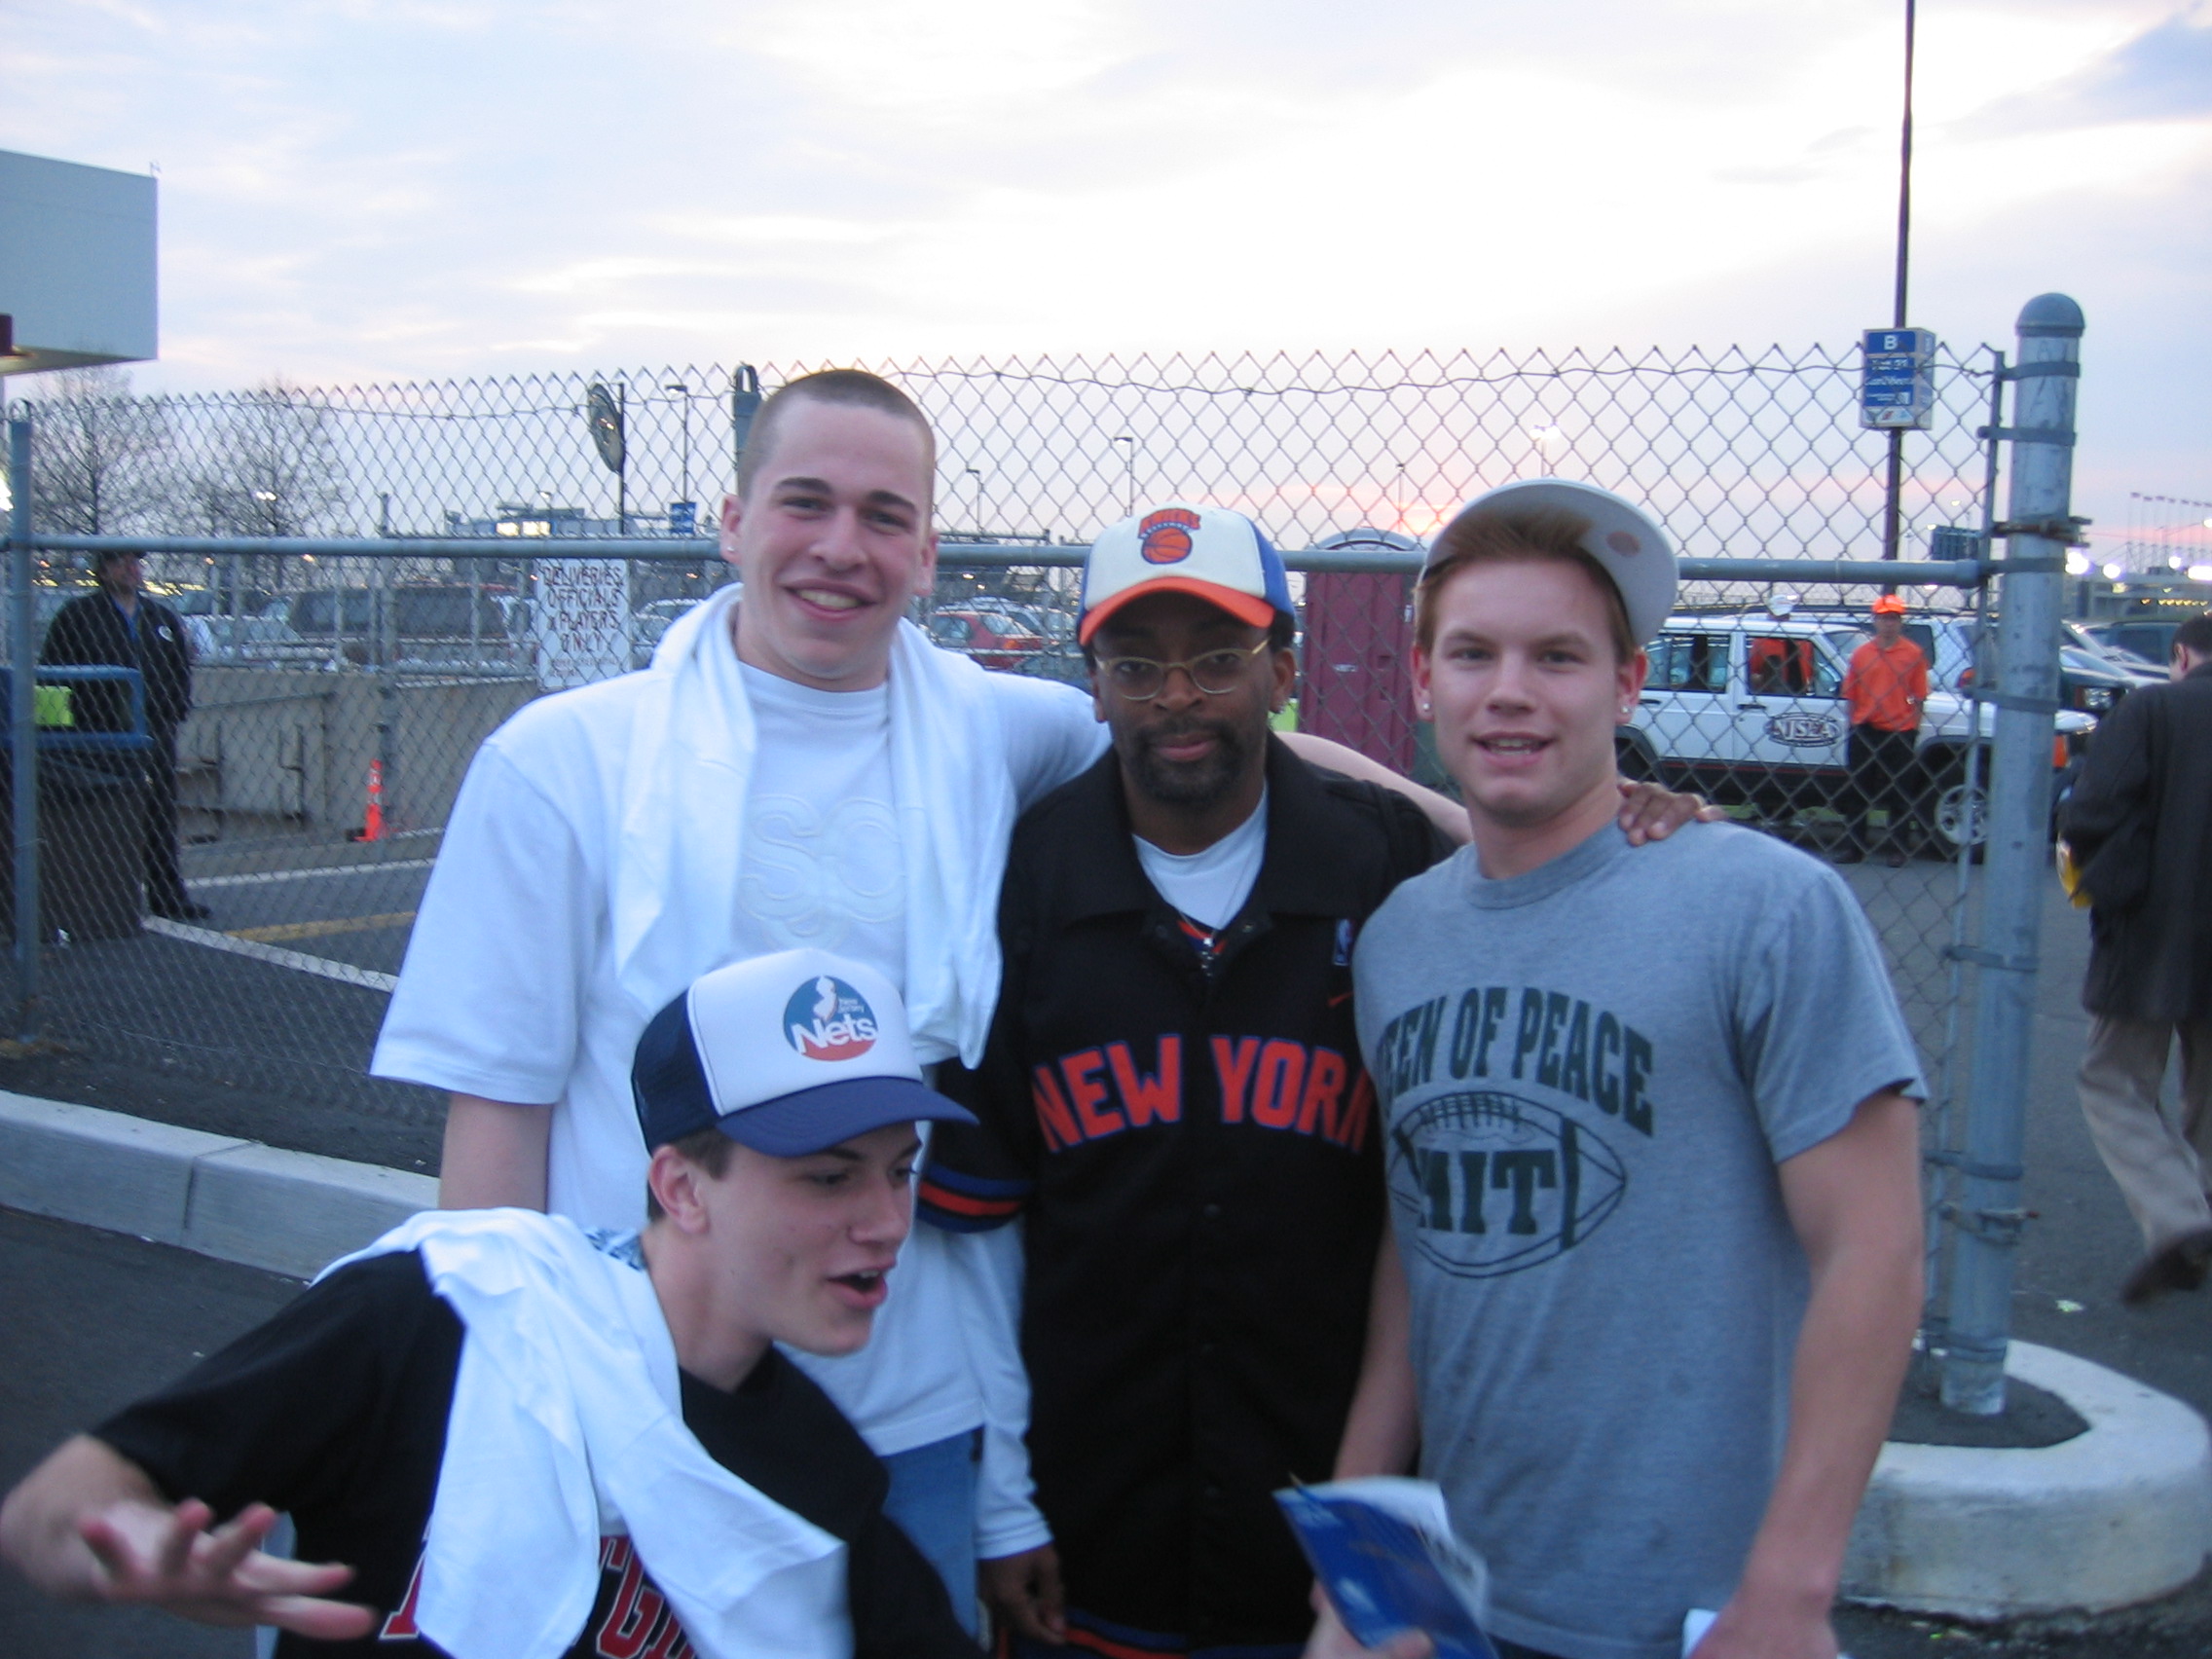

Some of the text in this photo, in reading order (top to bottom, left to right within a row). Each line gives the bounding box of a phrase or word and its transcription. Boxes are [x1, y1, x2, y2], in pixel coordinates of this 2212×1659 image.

[1883, 335, 1898, 350] B
[790, 1013, 878, 1054] Nets
[1450, 987, 1508, 1080] OF
[1511, 986, 1654, 1138] PEACE
[1031, 1032, 1181, 1154] NEW
